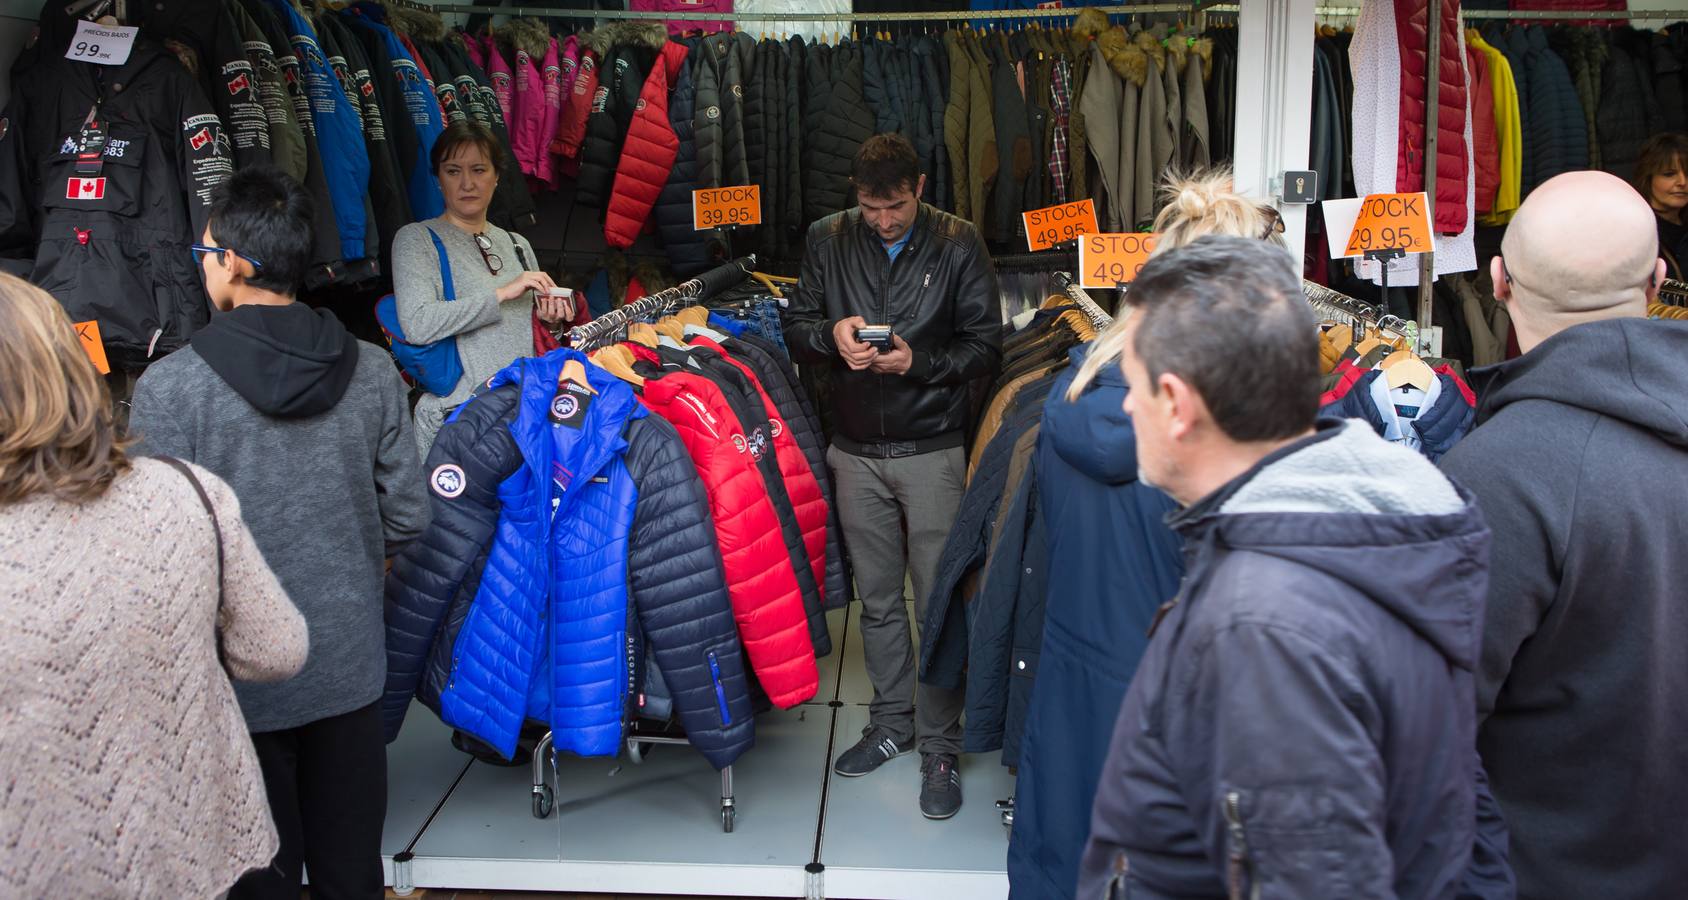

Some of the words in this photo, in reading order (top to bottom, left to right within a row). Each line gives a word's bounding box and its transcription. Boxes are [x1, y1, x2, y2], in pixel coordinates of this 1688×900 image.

[84, 28, 110, 37] PRECIOS
[110, 31, 130, 39] BAJOS
[700, 188, 755, 205] STOCK
[1031, 202, 1089, 226] STOCK
[1036, 222, 1088, 245] 49.95
[1349, 226, 1423, 251] 29.95€
[1091, 235, 1155, 255] STOC
